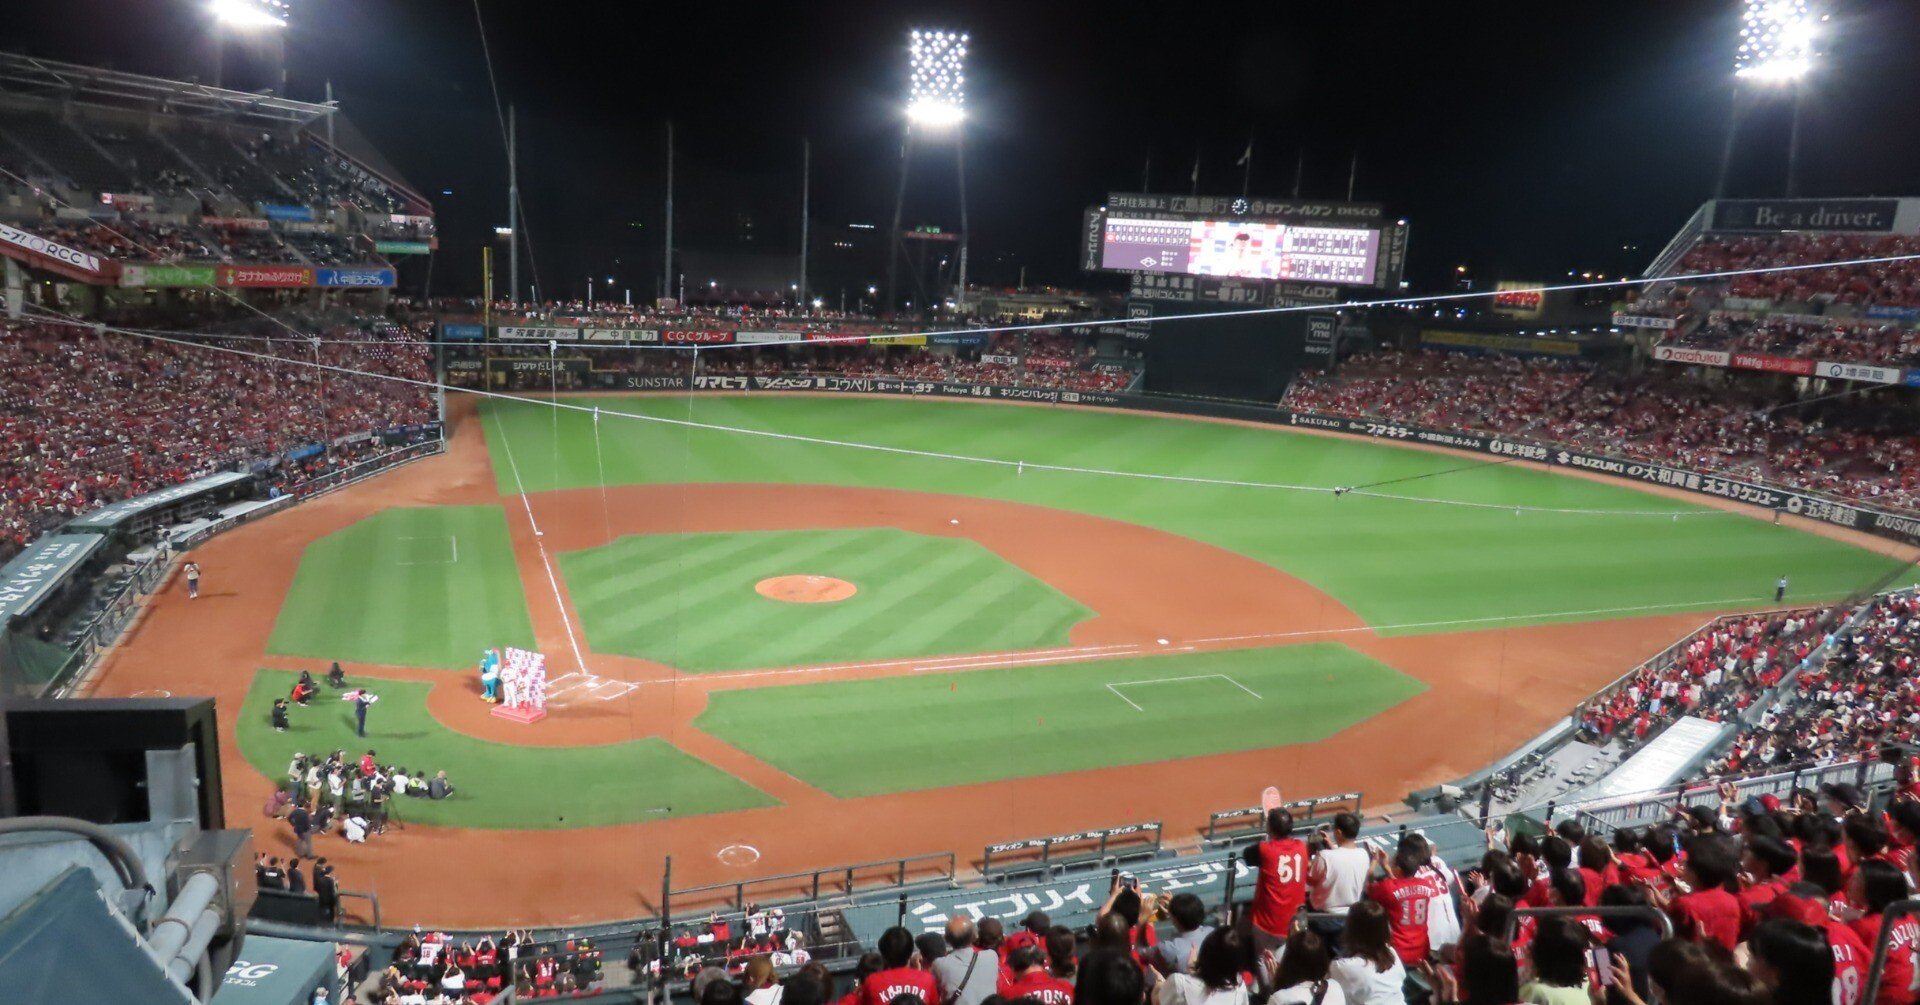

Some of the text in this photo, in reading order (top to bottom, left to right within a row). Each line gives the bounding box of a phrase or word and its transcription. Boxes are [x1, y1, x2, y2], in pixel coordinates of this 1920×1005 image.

[1337, 207, 1380, 217] DISCO
[1755, 206, 1881, 227] Be a driver.
[46, 243, 83, 264] RCC
[237, 270, 303, 283] タナカのふりかけ
[1131, 307, 1149, 317] you
[1310, 321, 1331, 331] you
[610, 330, 655, 341] 中国電力
[667, 331, 728, 341] CGCグループ
[1312, 330, 1331, 339] me
[627, 377, 684, 388] SUNSTAR
[694, 376, 748, 389] クマヒラ
[828, 379, 875, 392] ユウベル
[1299, 416, 1341, 428] SAKURAO
[1366, 422, 1415, 438] フマキラー
[1571, 454, 1625, 474] SUZUKI
[1804, 499, 1859, 528] 五洋建設
[1277, 853, 1302, 884] 51
[1400, 898, 1428, 926] 18
